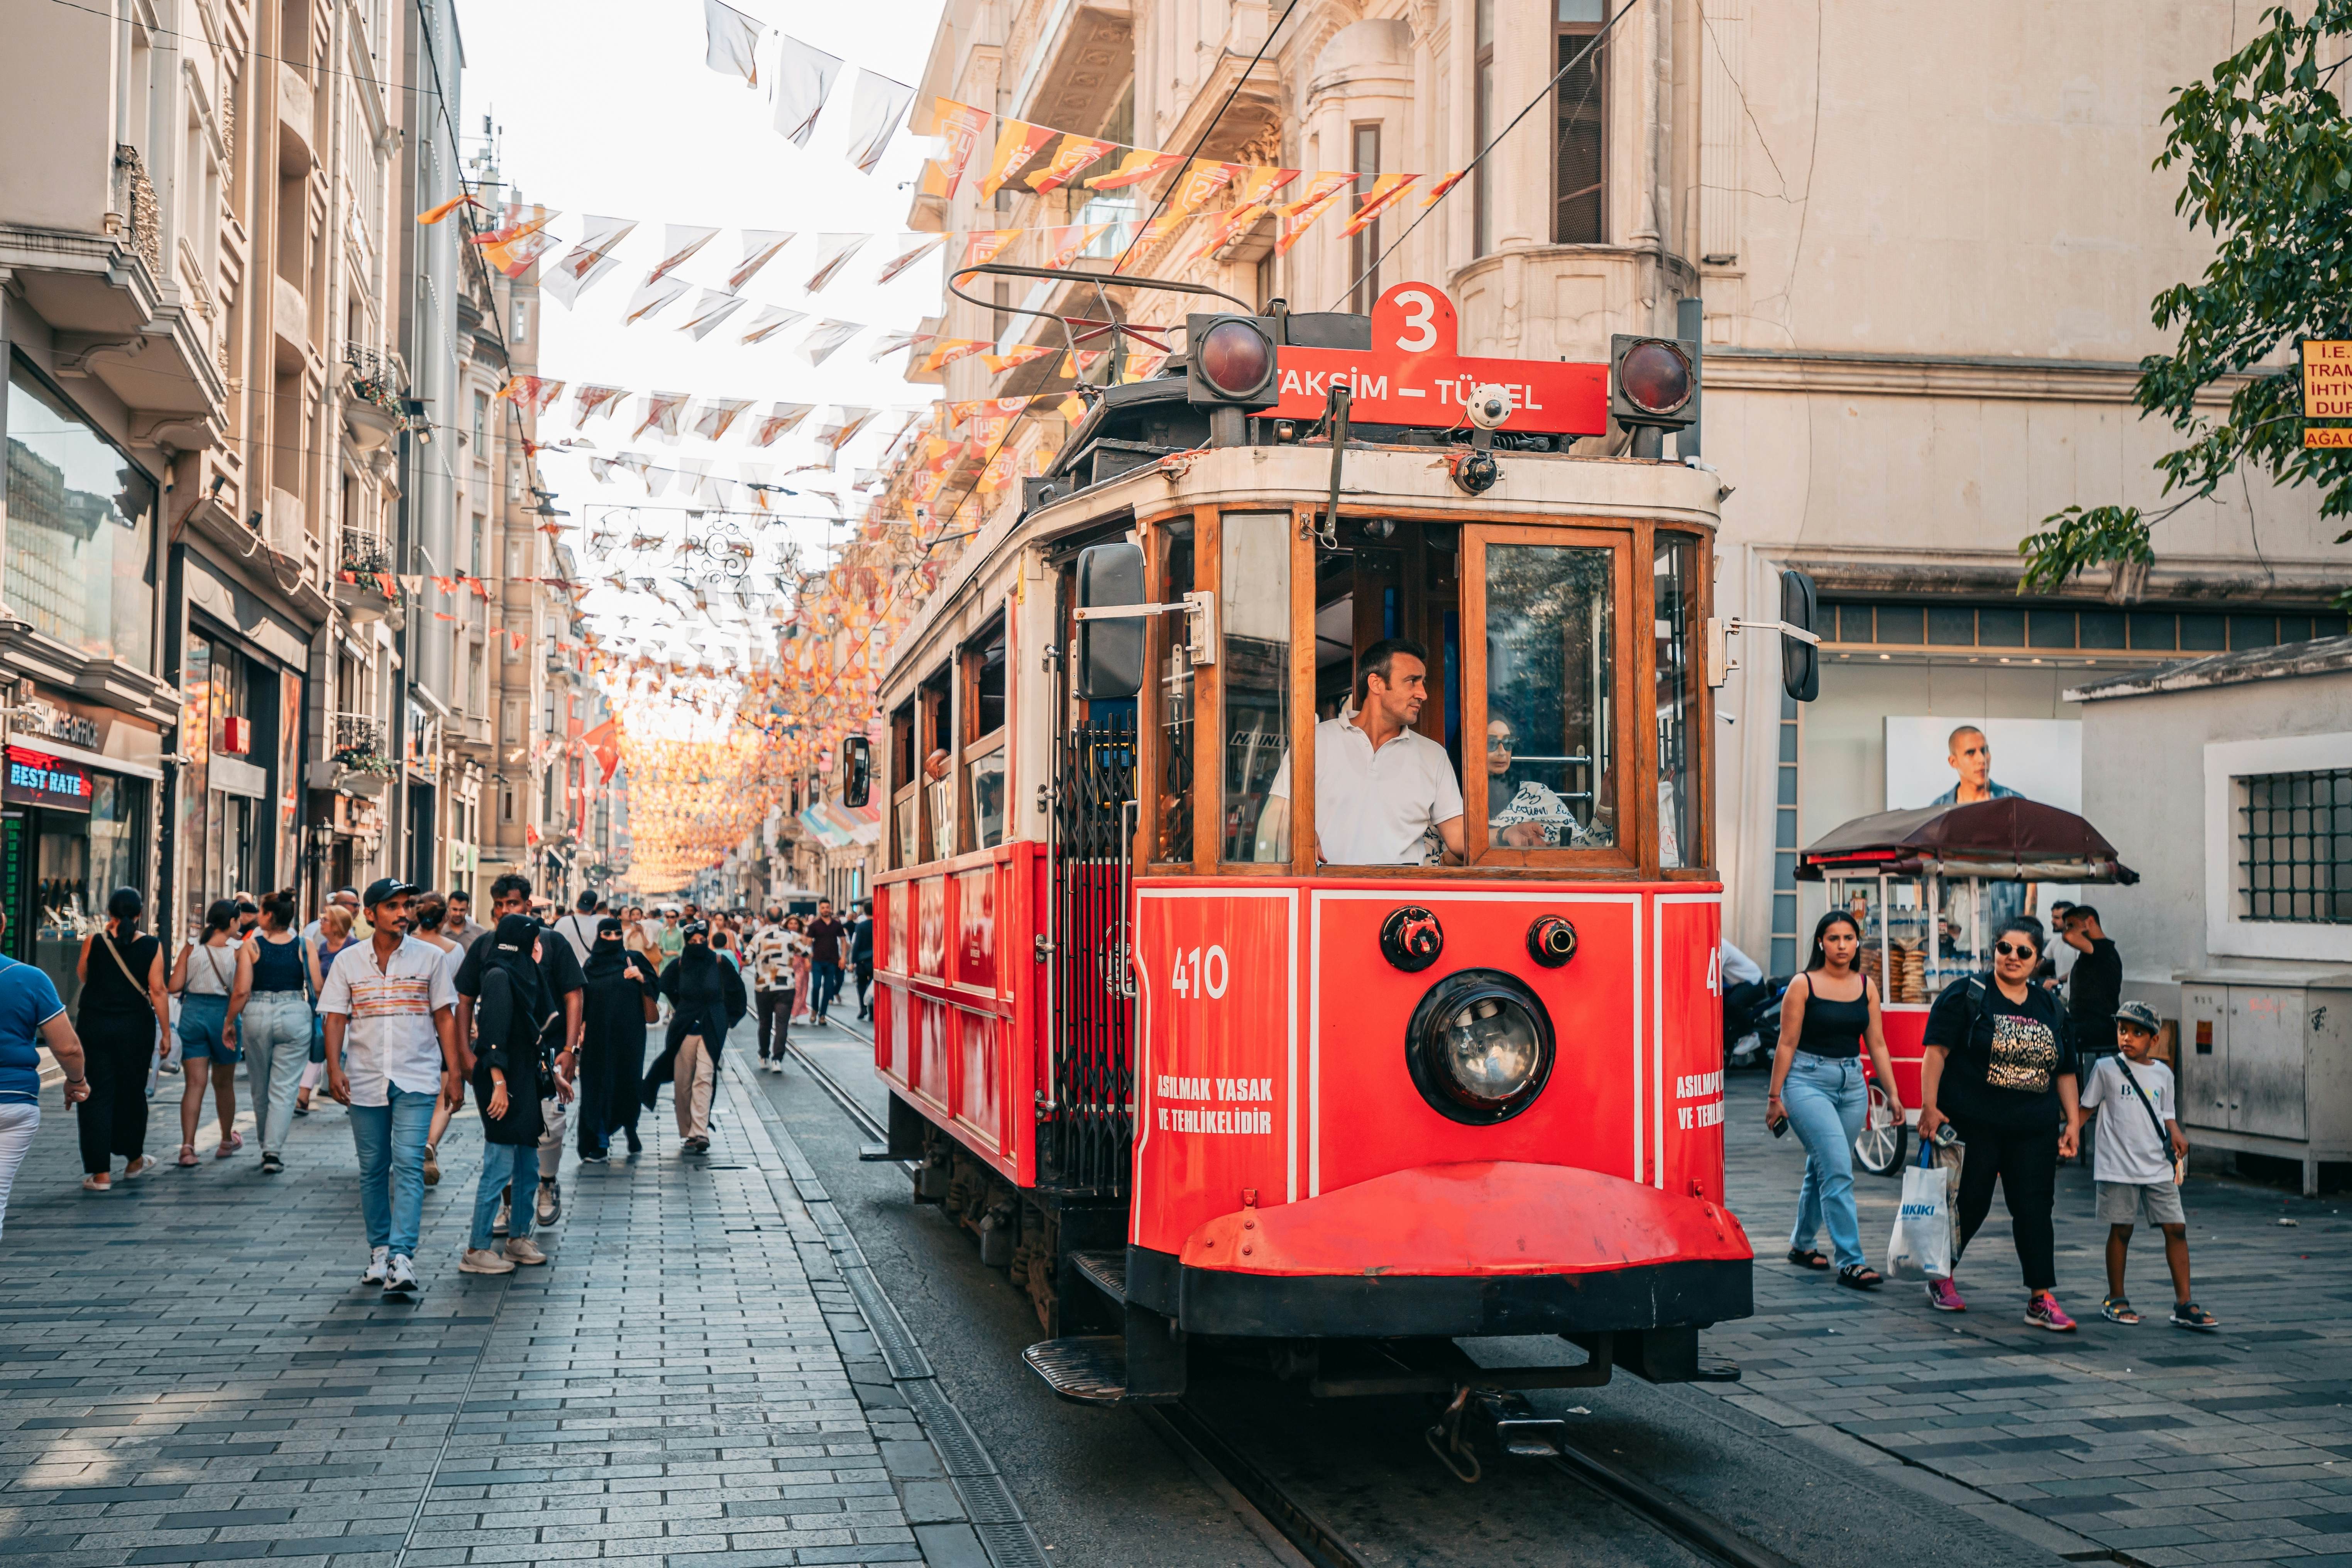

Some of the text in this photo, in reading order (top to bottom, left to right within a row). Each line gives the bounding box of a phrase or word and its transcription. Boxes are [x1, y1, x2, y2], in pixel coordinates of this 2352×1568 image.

[1393, 289, 1438, 352] 3
[2322, 343, 2352, 358] İ.E.
[1435, 374, 1543, 410] TÜEL
[2305, 429, 2344, 445] AĞA
[71, 715, 99, 748] OFFICE
[11, 763, 82, 796] BEST RATE
[1172, 944, 1229, 1000] 410
[1157, 1074, 1272, 1101] ASILMAK YASAK
[1676, 1071, 1719, 1099] ASILMAK
[2121, 1084, 2159, 1102] BSS
[1157, 1106, 1271, 1134] VE TEHLİKELİDİR
[1677, 1106, 1694, 1130] VE
